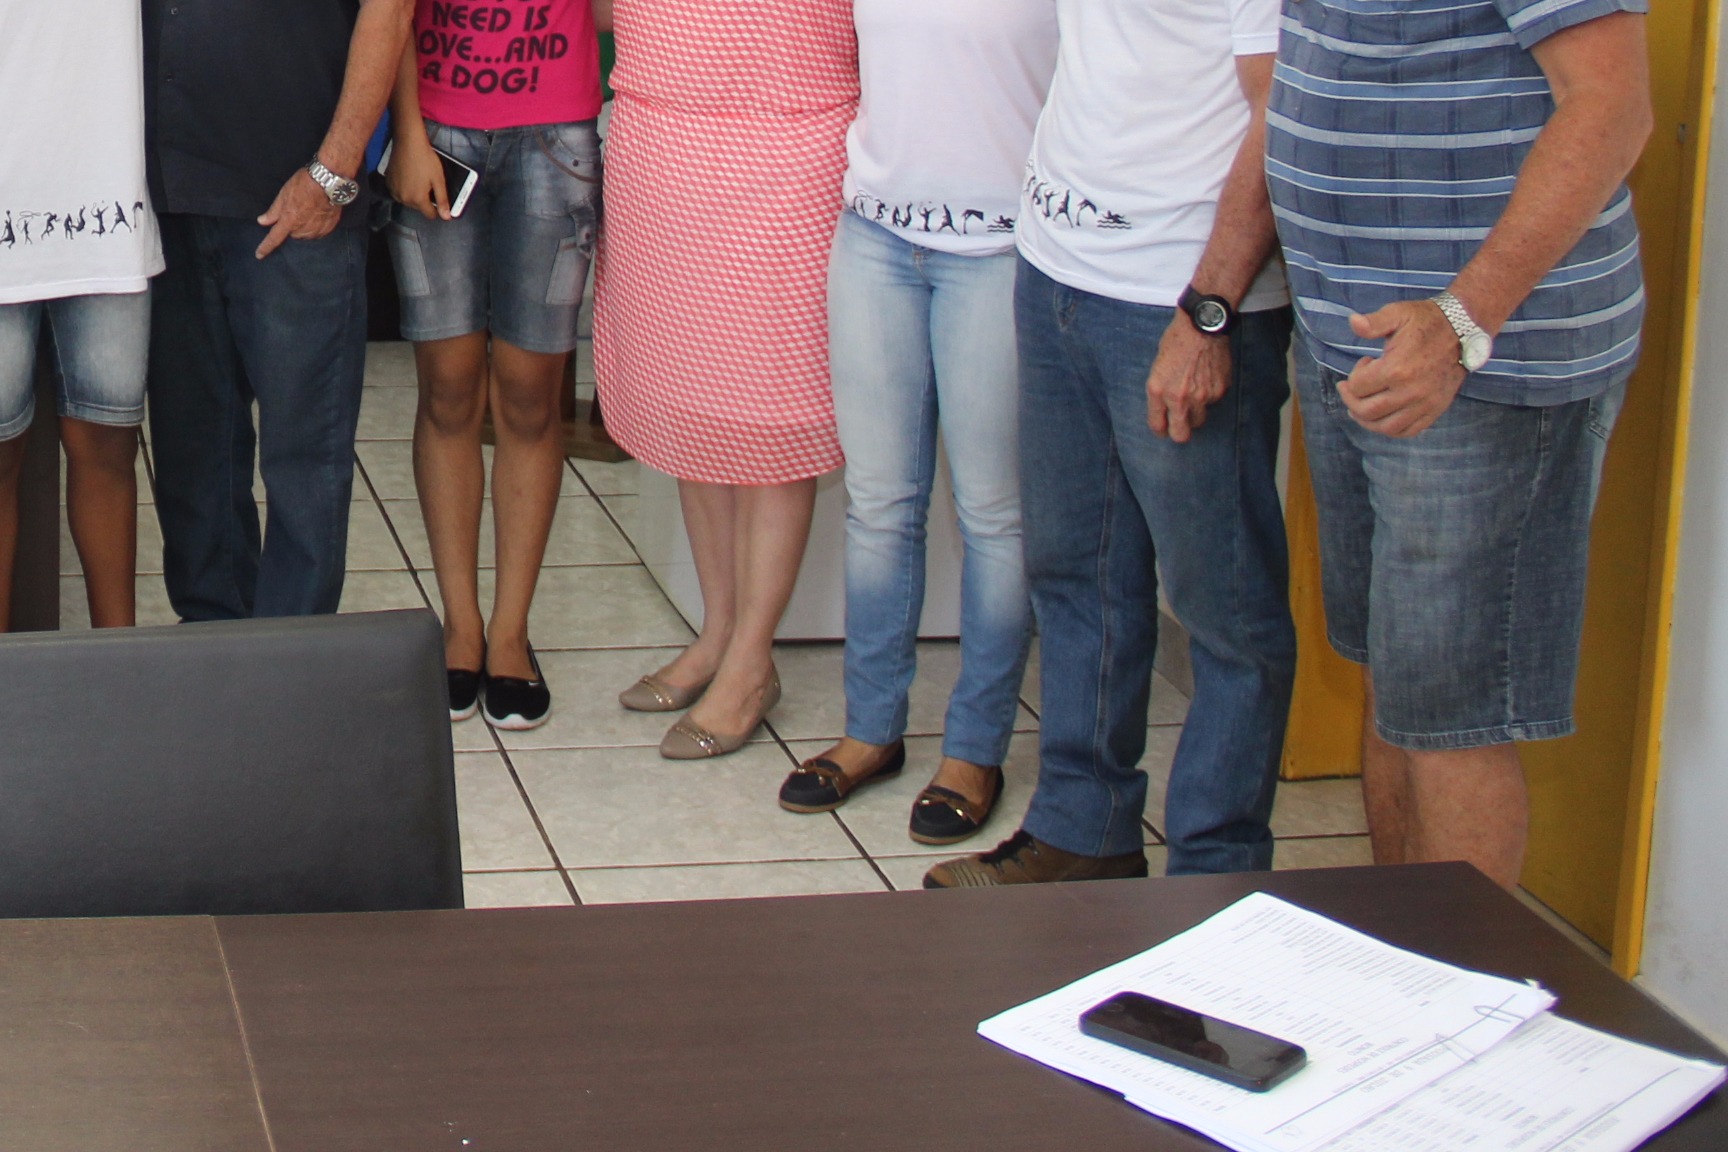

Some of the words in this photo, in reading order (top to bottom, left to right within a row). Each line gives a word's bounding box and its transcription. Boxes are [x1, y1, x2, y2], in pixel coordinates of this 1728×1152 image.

[432, 1, 512, 32] NEED
[523, 5, 550, 32] IS
[418, 29, 569, 63] OVE...AND
[422, 60, 441, 84] A
[451, 64, 539, 94] DOG!
